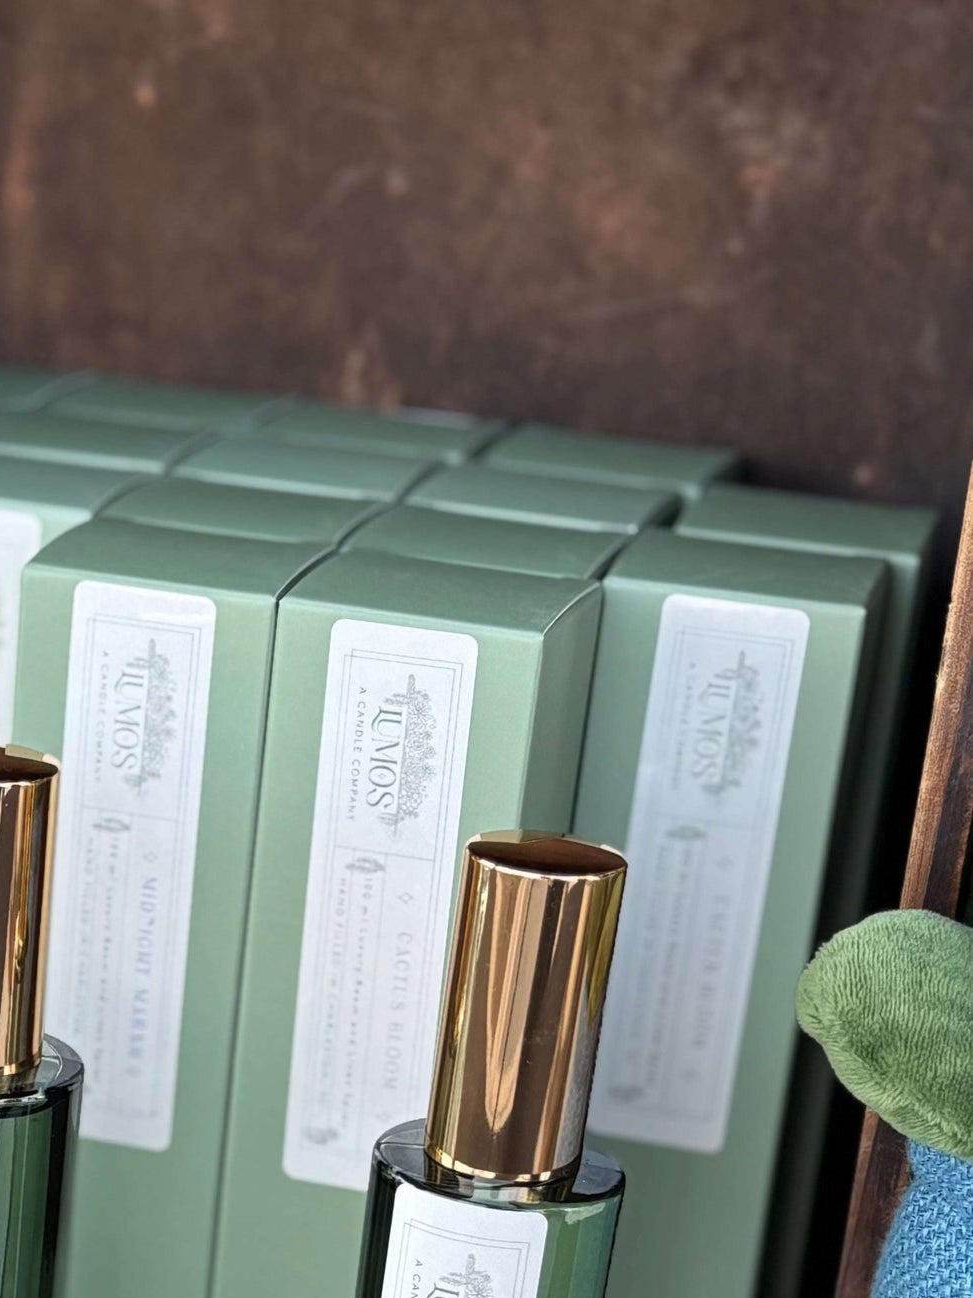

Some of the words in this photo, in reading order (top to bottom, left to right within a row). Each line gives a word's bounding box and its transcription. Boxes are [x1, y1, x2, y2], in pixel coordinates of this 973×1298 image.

[110, 670, 144, 770] LUMOS
[354, 702, 366, 752] CANDLE
[366, 706, 402, 808] LUMOS
[348, 760, 360, 822] COMPANY
